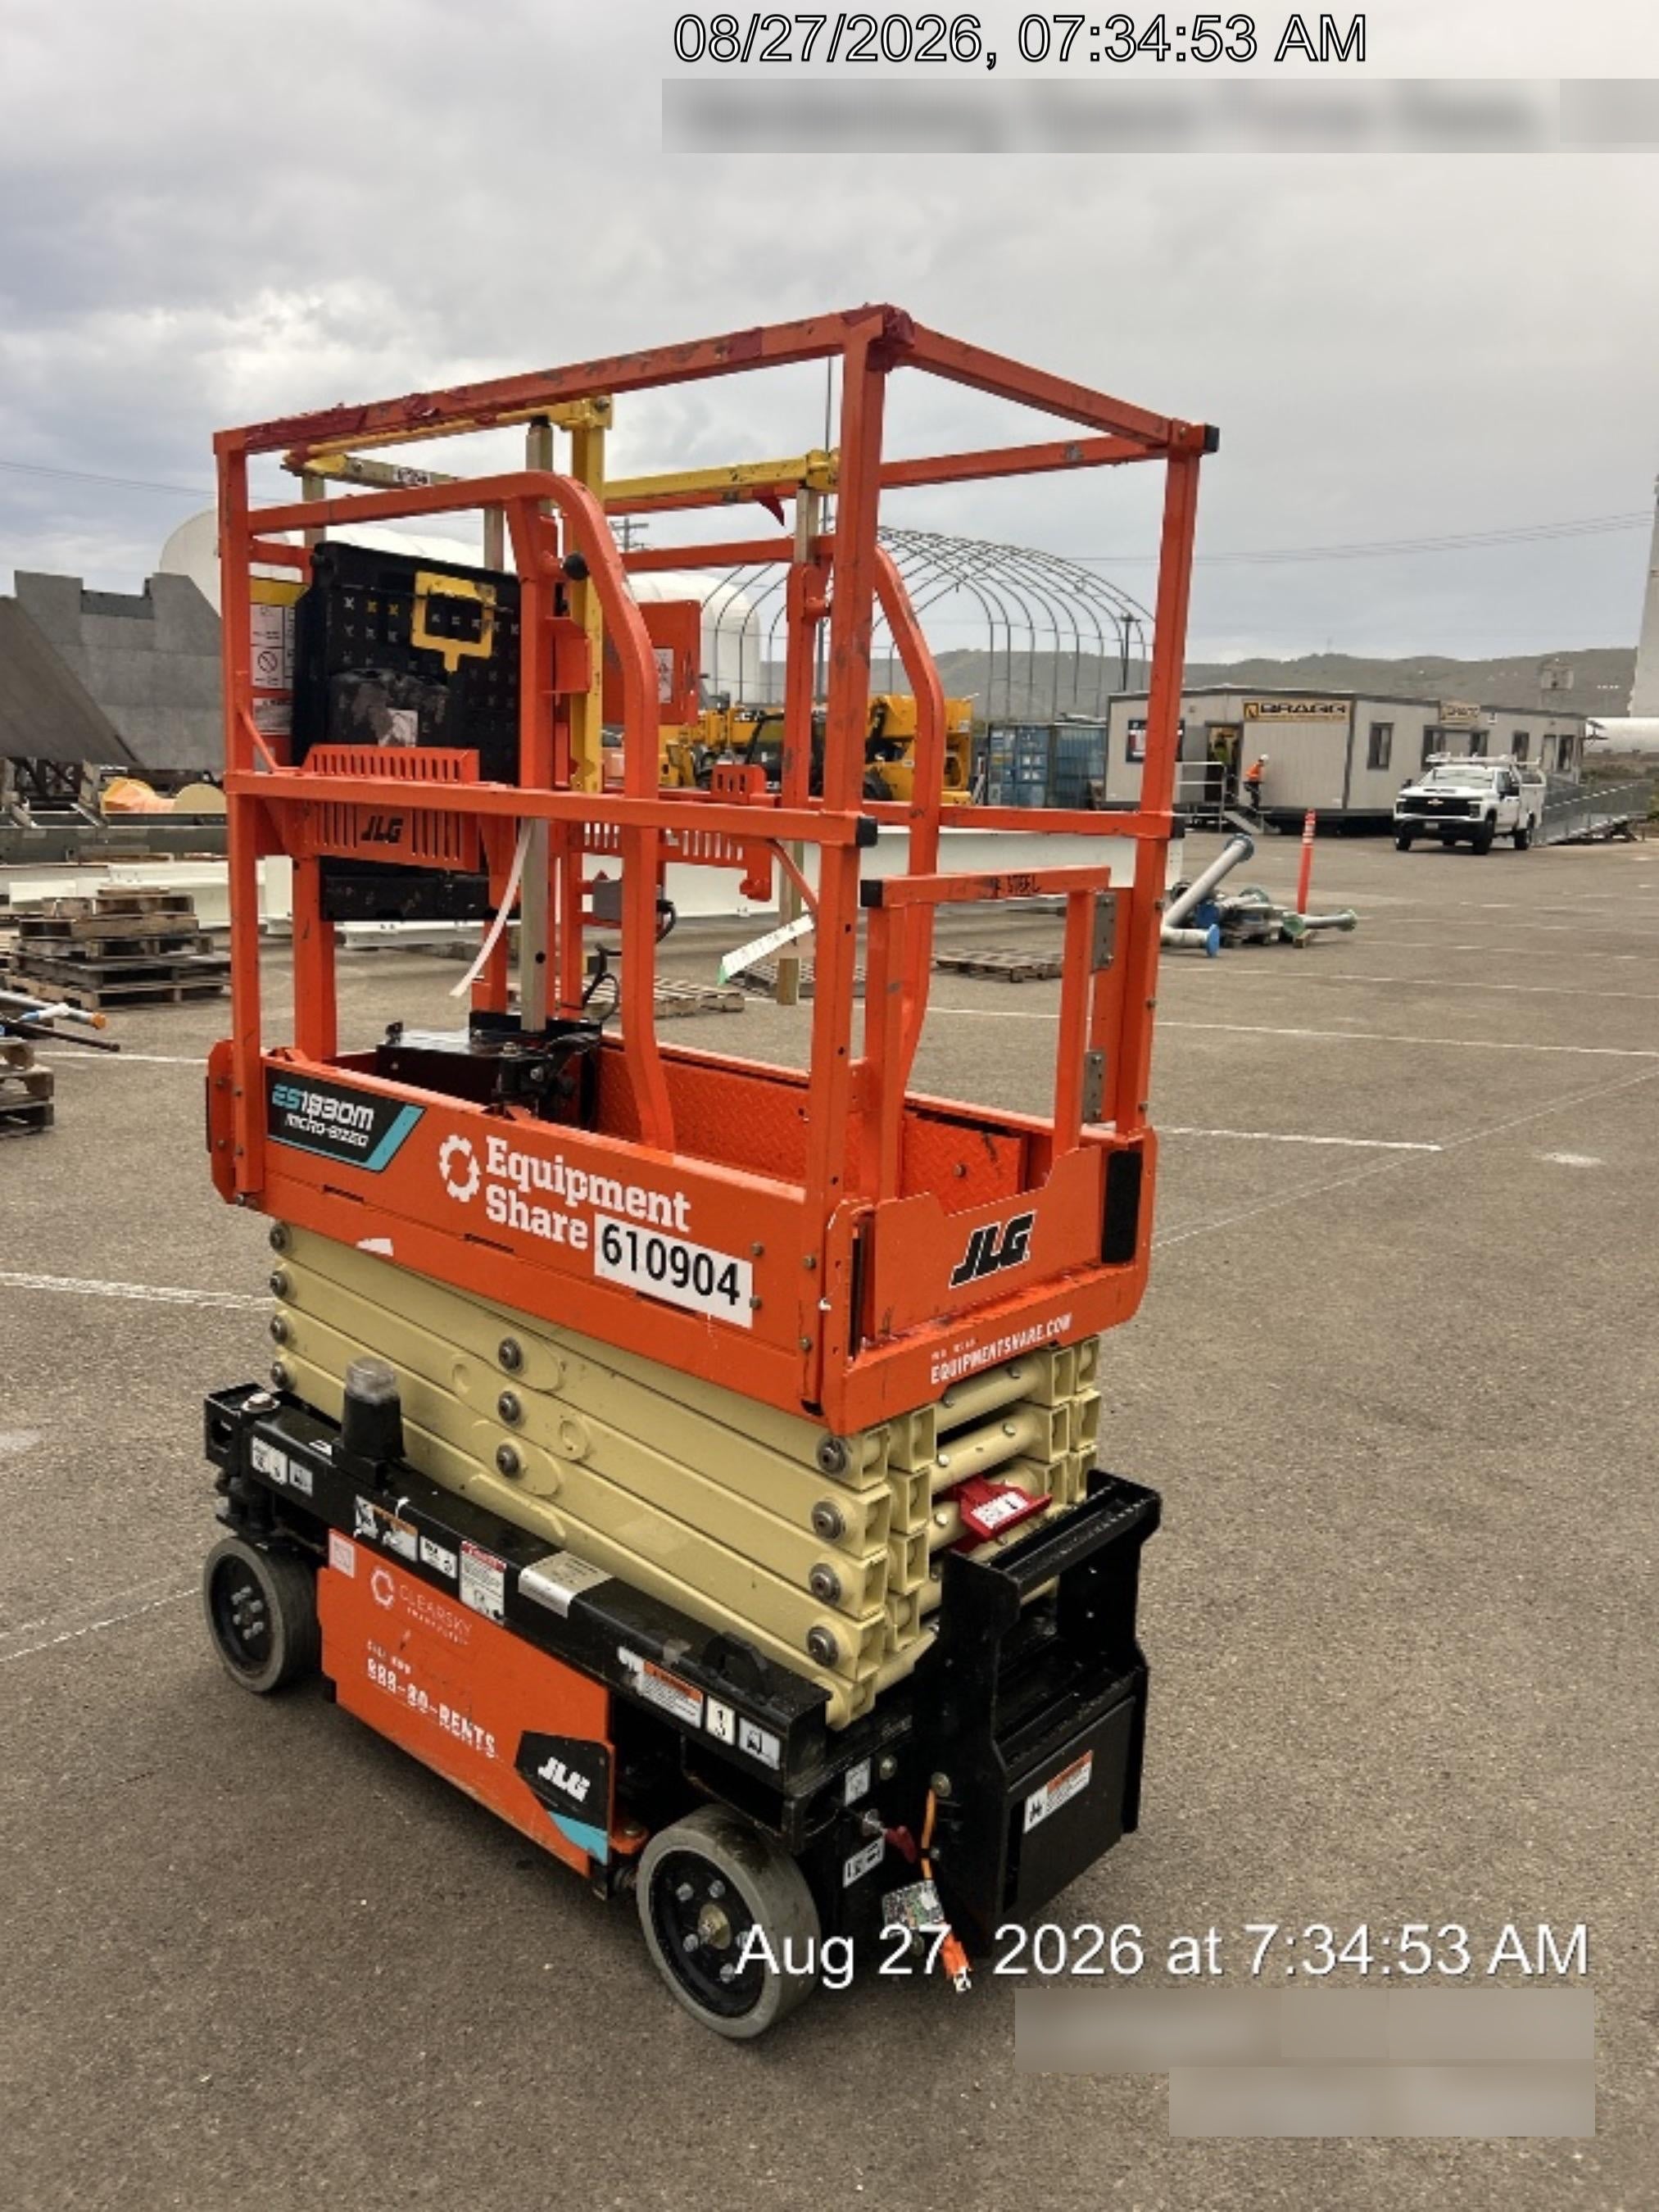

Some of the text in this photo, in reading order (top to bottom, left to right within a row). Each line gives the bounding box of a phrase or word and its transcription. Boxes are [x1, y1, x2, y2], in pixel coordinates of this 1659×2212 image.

[360, 814, 404, 844] JLG
[486, 1135, 692, 1233] Equipment
[486, 1184, 589, 1251] Share
[601, 1222, 741, 1306] 610904
[948, 1209, 1036, 1290] JLG
[930, 1312, 1072, 1385] EQUIPMENTSHARE.COM
[537, 1756, 591, 1803] JLG
